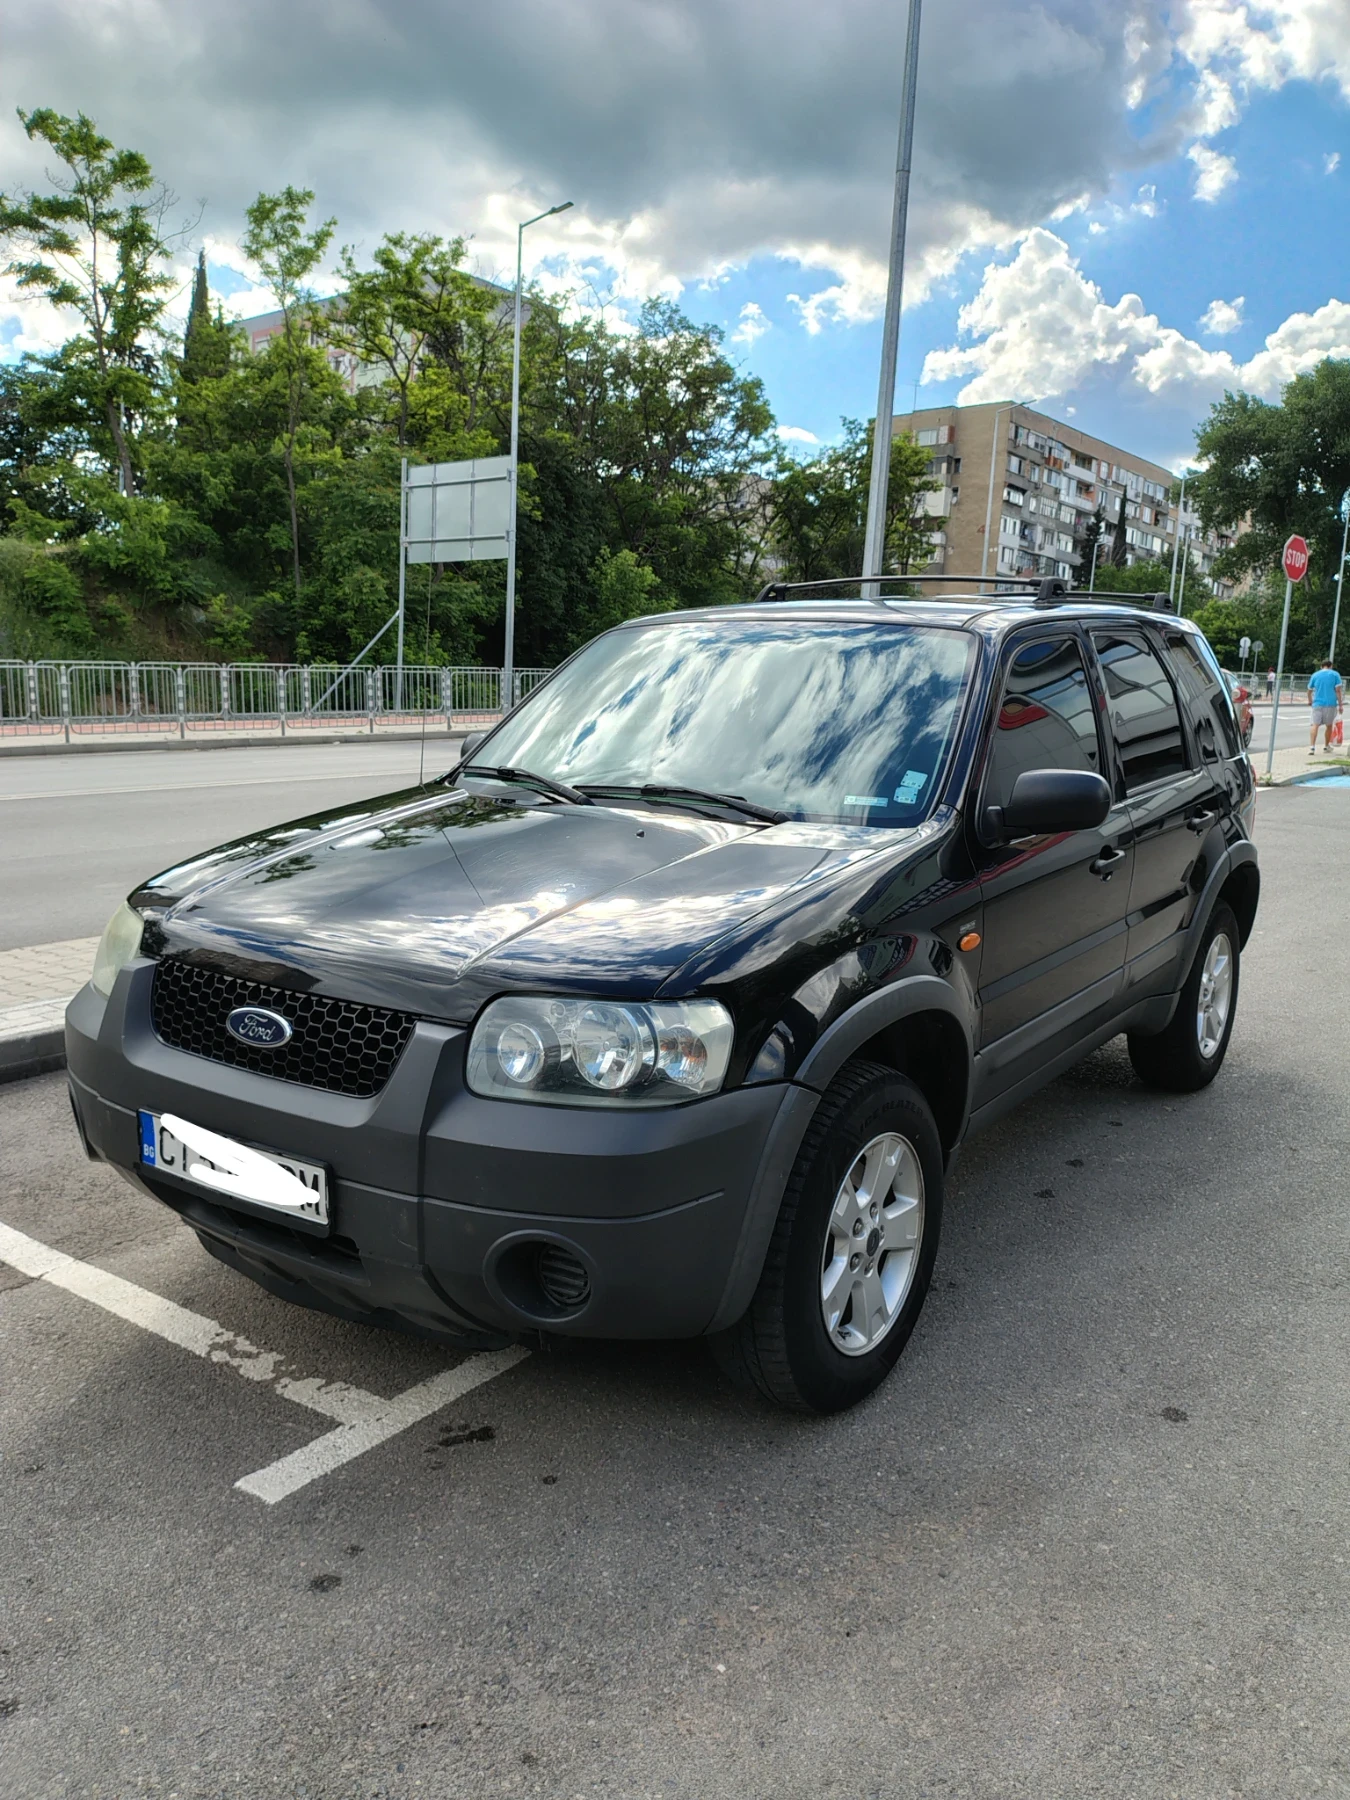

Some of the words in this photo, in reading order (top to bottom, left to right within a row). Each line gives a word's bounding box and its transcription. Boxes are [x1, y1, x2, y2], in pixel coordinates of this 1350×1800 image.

[1286, 548, 1306, 569] STOP
[239, 1013, 276, 1041] Ford
[143, 1143, 155, 1158] BG
